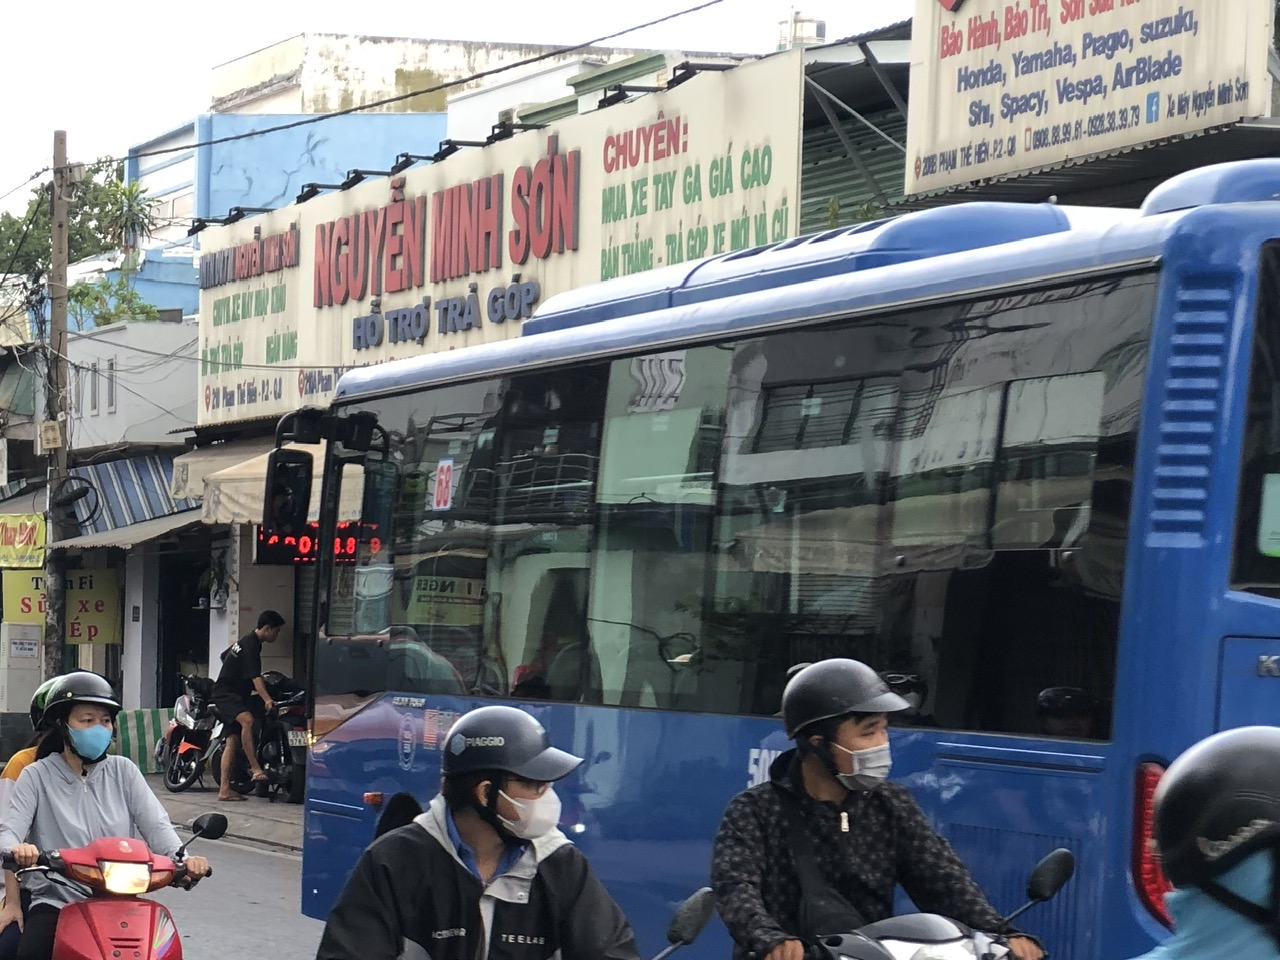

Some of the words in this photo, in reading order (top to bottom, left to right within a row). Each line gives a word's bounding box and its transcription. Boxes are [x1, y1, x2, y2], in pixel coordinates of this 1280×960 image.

[940, 21, 963, 59] Bảo
[957, 59, 1007, 93] Honda,
[1012, 41, 1077, 78] Yamaha,
[1140, 6, 1198, 44] suzuki,
[1000, 89, 1049, 123] Spacy,
[1056, 74, 1107, 106] Vespa,
[1111, 50, 1183, 91] AirBlade
[1217, 79, 1233, 106] Minh
[603, 110, 689, 173] CHUYÊN:
[601, 183, 627, 224] MUA
[630, 177, 648, 217] XE
[652, 169, 677, 212] TAY
[682, 163, 702, 205] GA
[709, 141, 733, 198] GIÁ
[740, 144, 772, 190] CAO
[313, 176, 426, 309] NGUYỄN
[430, 172, 504, 284] MINH
[509, 134, 580, 265] SƠN
[600, 235, 619, 282] BÁN
[666, 219, 684, 266] TRẢ
[686, 214, 708, 262] GÓP
[713, 222, 726, 255] XE
[731, 204, 750, 251] MỚI
[754, 200, 768, 246] VÀ
[772, 197, 789, 242] CŨ
[352, 297, 384, 350] HỖ
[385, 296, 431, 345] TRỢ
[435, 282, 482, 334] TRẢ
[487, 273, 540, 323] GÓP
[78, 575, 94, 590] Fi
[78, 599, 105, 613] xe
[70, 616, 99, 641] Ép
[466, 736, 505, 748] PIAGGIO
